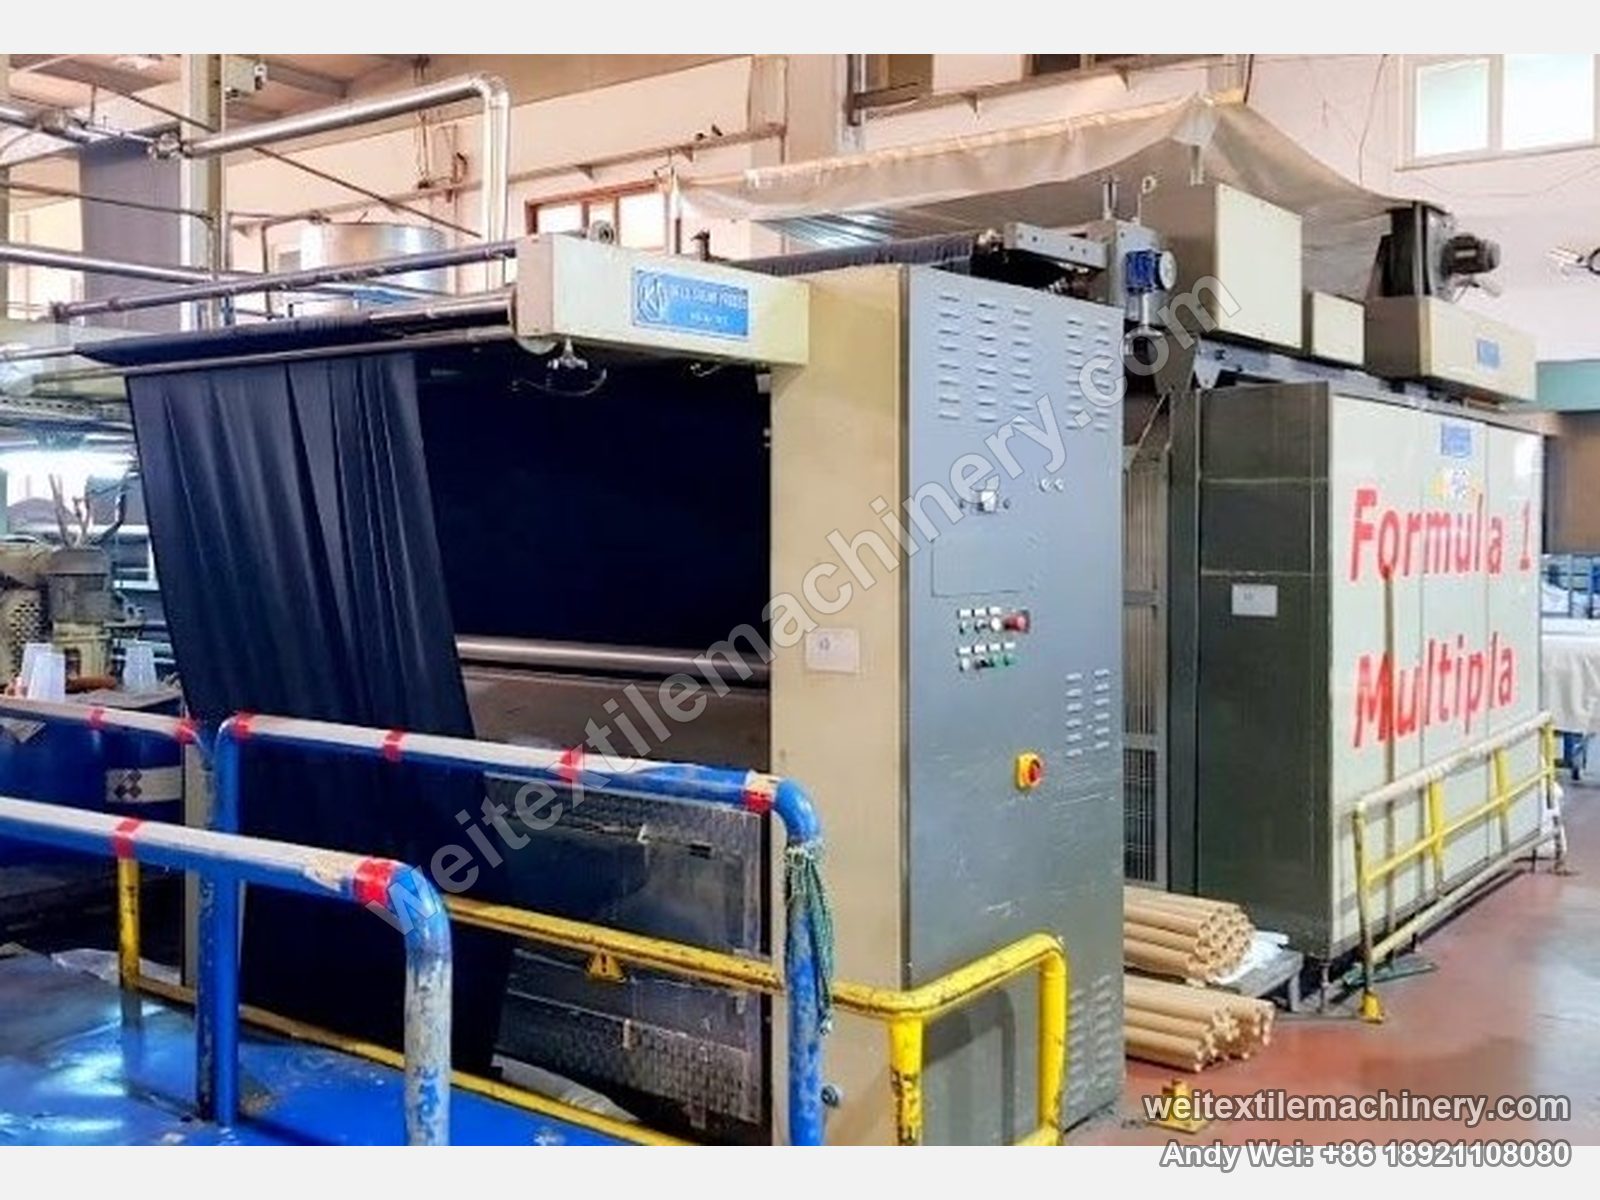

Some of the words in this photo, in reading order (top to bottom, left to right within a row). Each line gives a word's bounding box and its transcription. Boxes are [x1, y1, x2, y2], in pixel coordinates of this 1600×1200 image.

[1349, 488, 1504, 581] Formula
[1518, 501, 1532, 572] 1
[1353, 631, 1515, 748] Multipla
